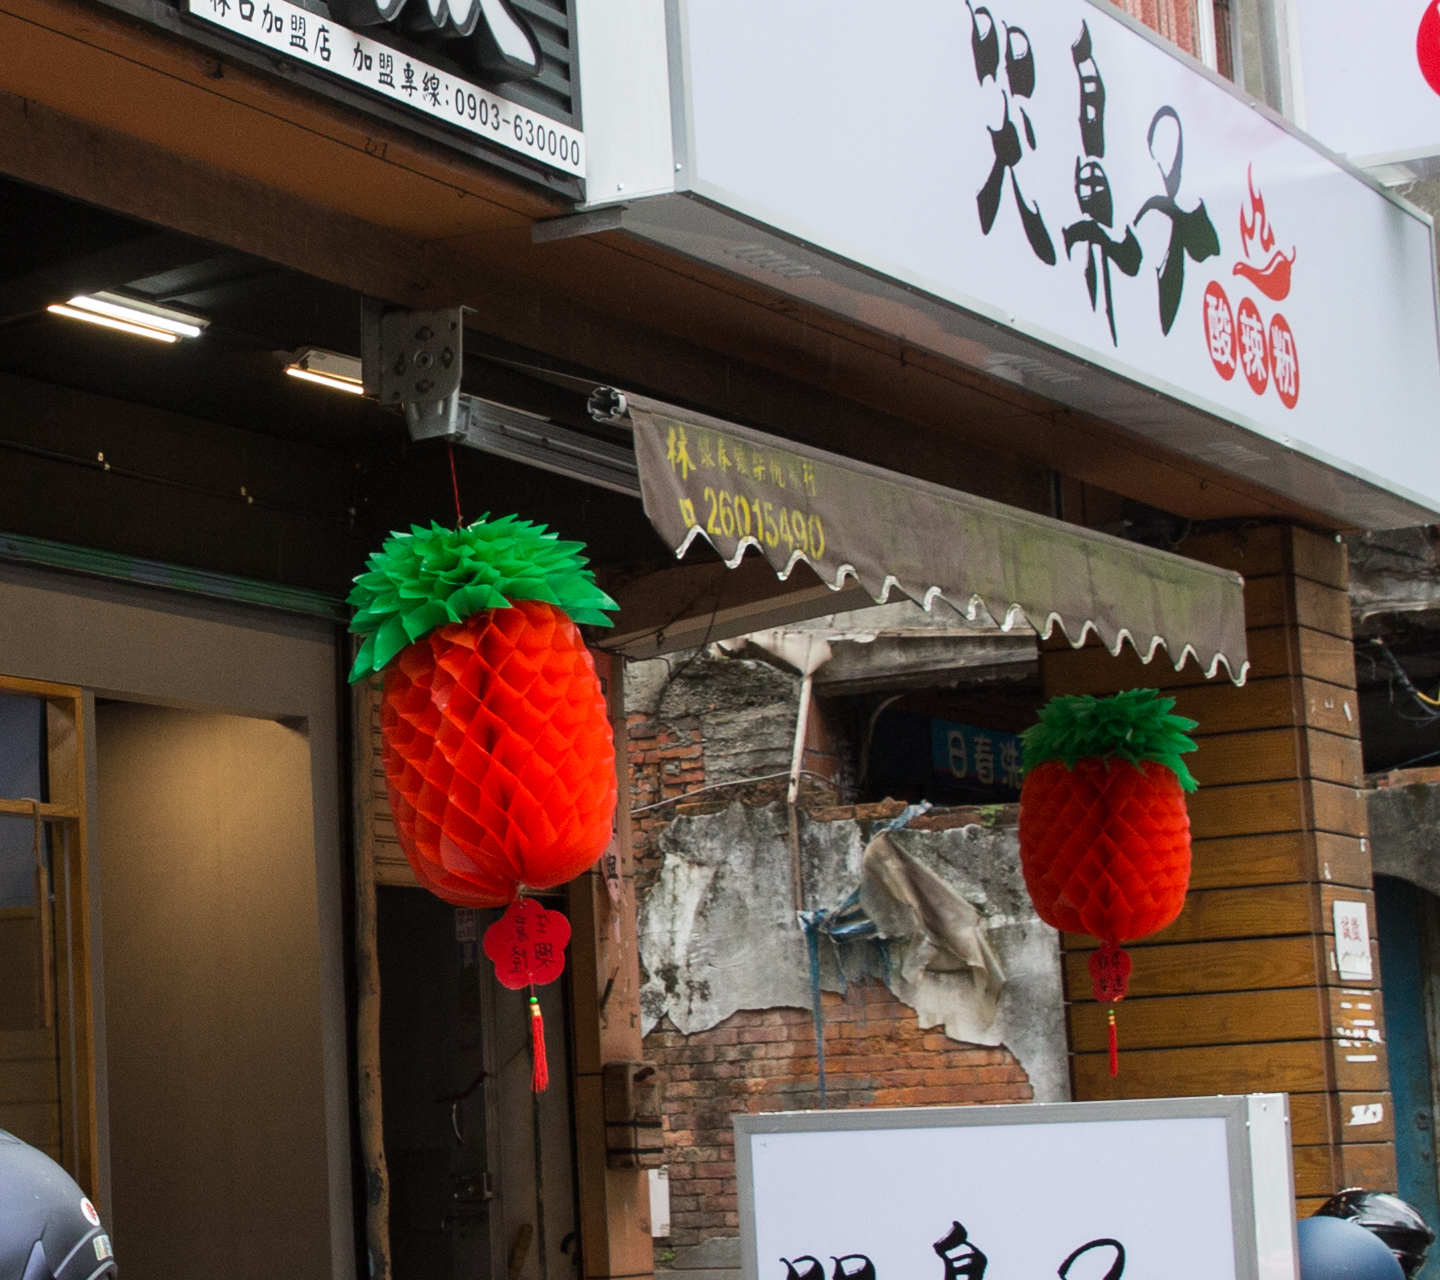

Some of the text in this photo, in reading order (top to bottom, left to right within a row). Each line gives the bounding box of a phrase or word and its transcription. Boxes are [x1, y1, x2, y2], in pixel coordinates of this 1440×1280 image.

[1205, 283, 1299, 408] 酸辣粉
[704, 486, 826, 560] 26015490
